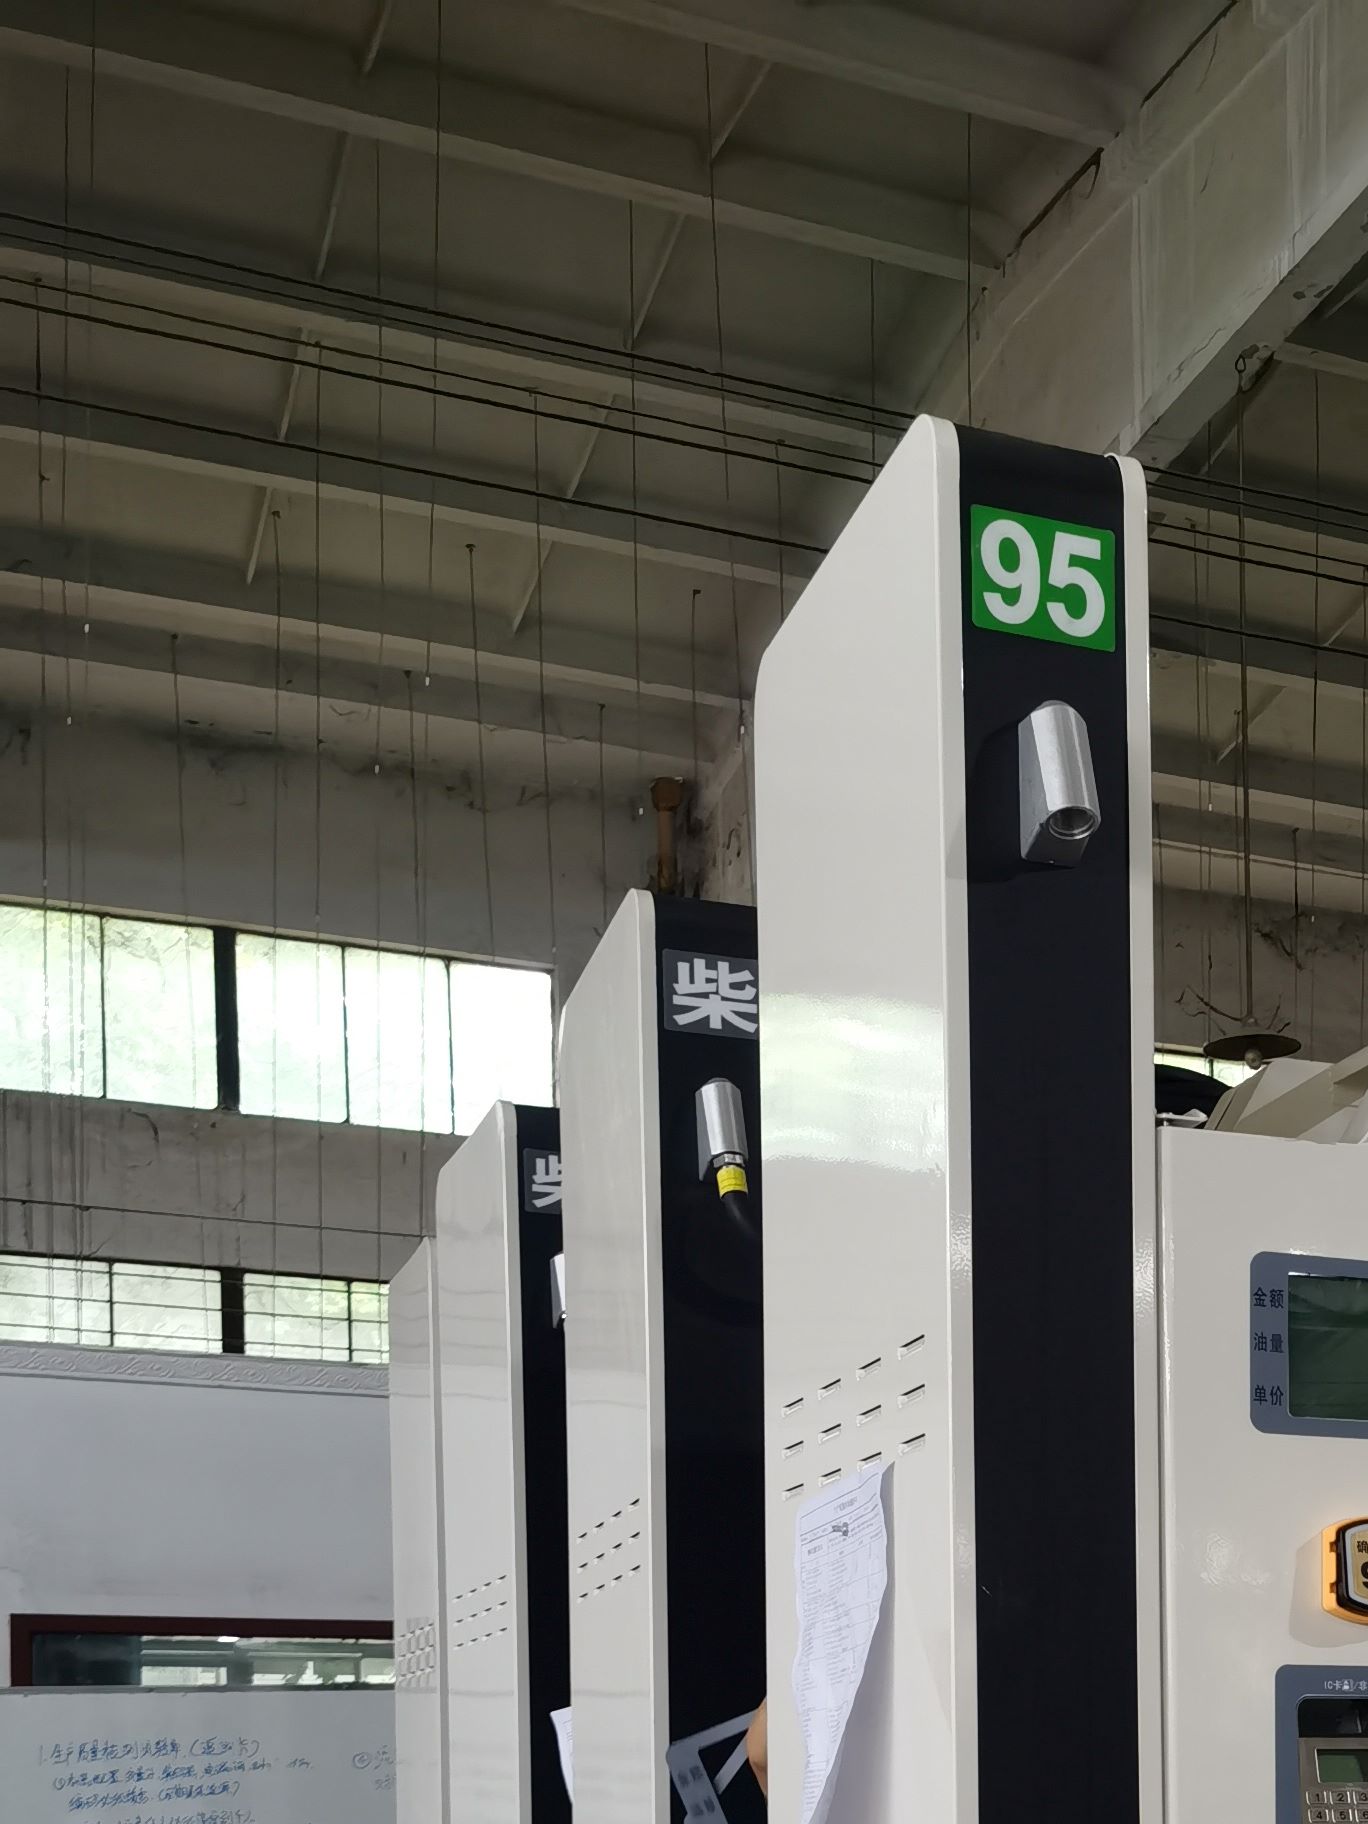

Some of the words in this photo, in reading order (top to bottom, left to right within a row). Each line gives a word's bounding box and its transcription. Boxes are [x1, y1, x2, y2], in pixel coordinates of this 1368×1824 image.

[980, 518, 1106, 638] 95
[672, 957, 758, 1033] 柴
[1253, 1286, 1284, 1309] 金额
[1253, 1332, 1285, 1354] 油量
[1253, 1384, 1284, 1407] 单价
